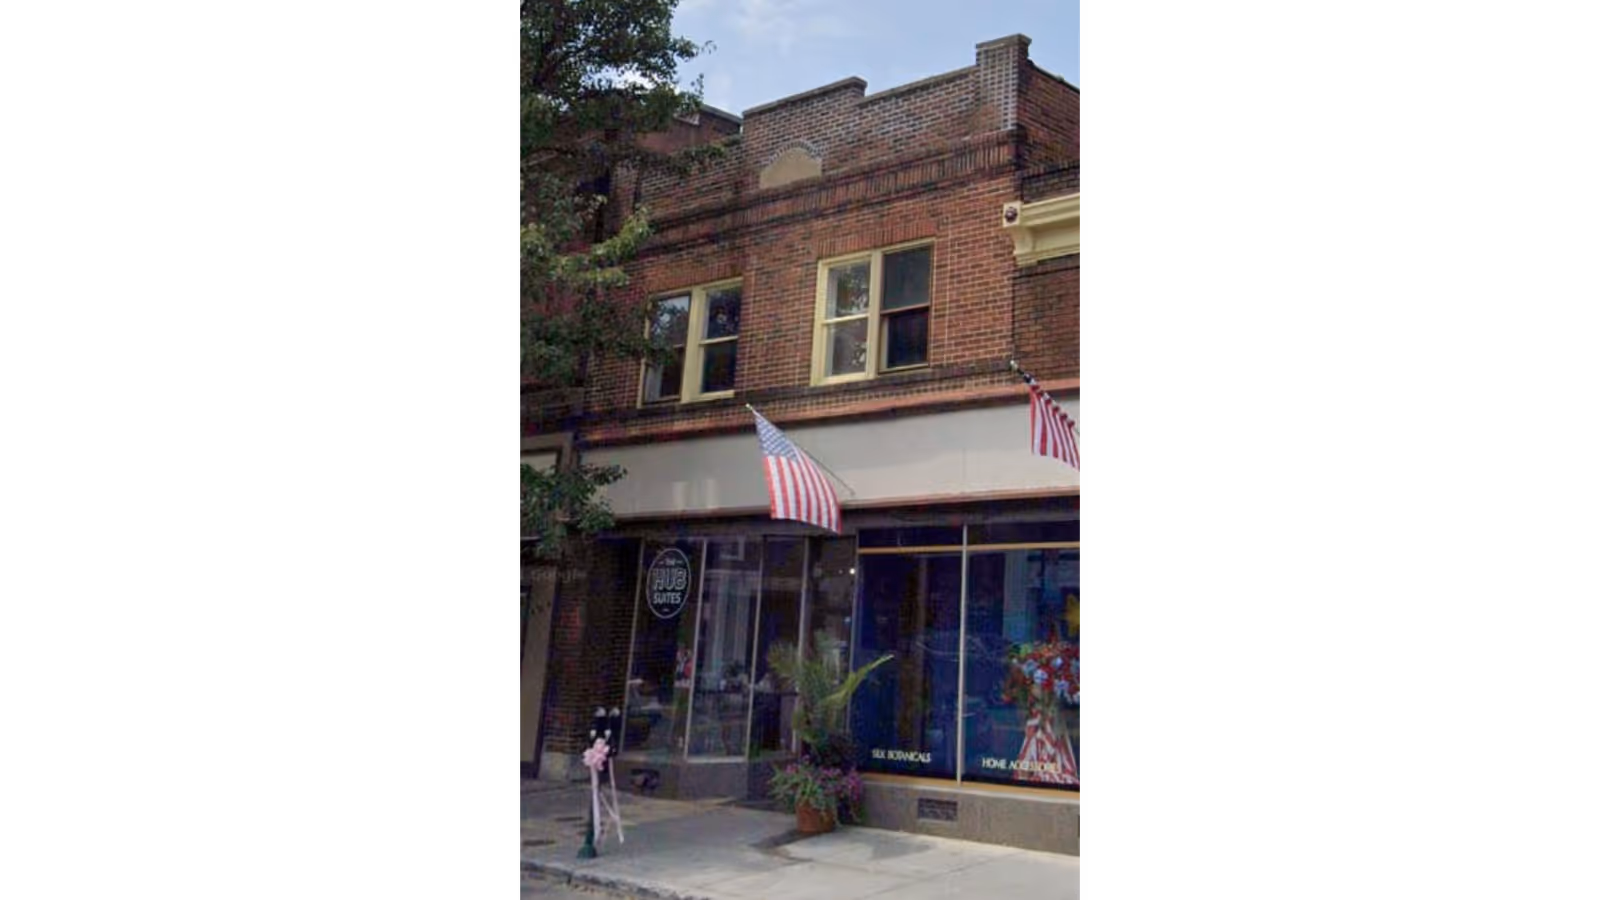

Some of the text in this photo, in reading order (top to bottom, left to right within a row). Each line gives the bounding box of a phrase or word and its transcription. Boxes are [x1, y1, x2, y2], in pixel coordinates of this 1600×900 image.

[652, 568, 687, 590] HUB
[653, 592, 681, 604] SUITES
[887, 750, 931, 763] BOTANICALS
[982, 757, 1007, 769] HOME
